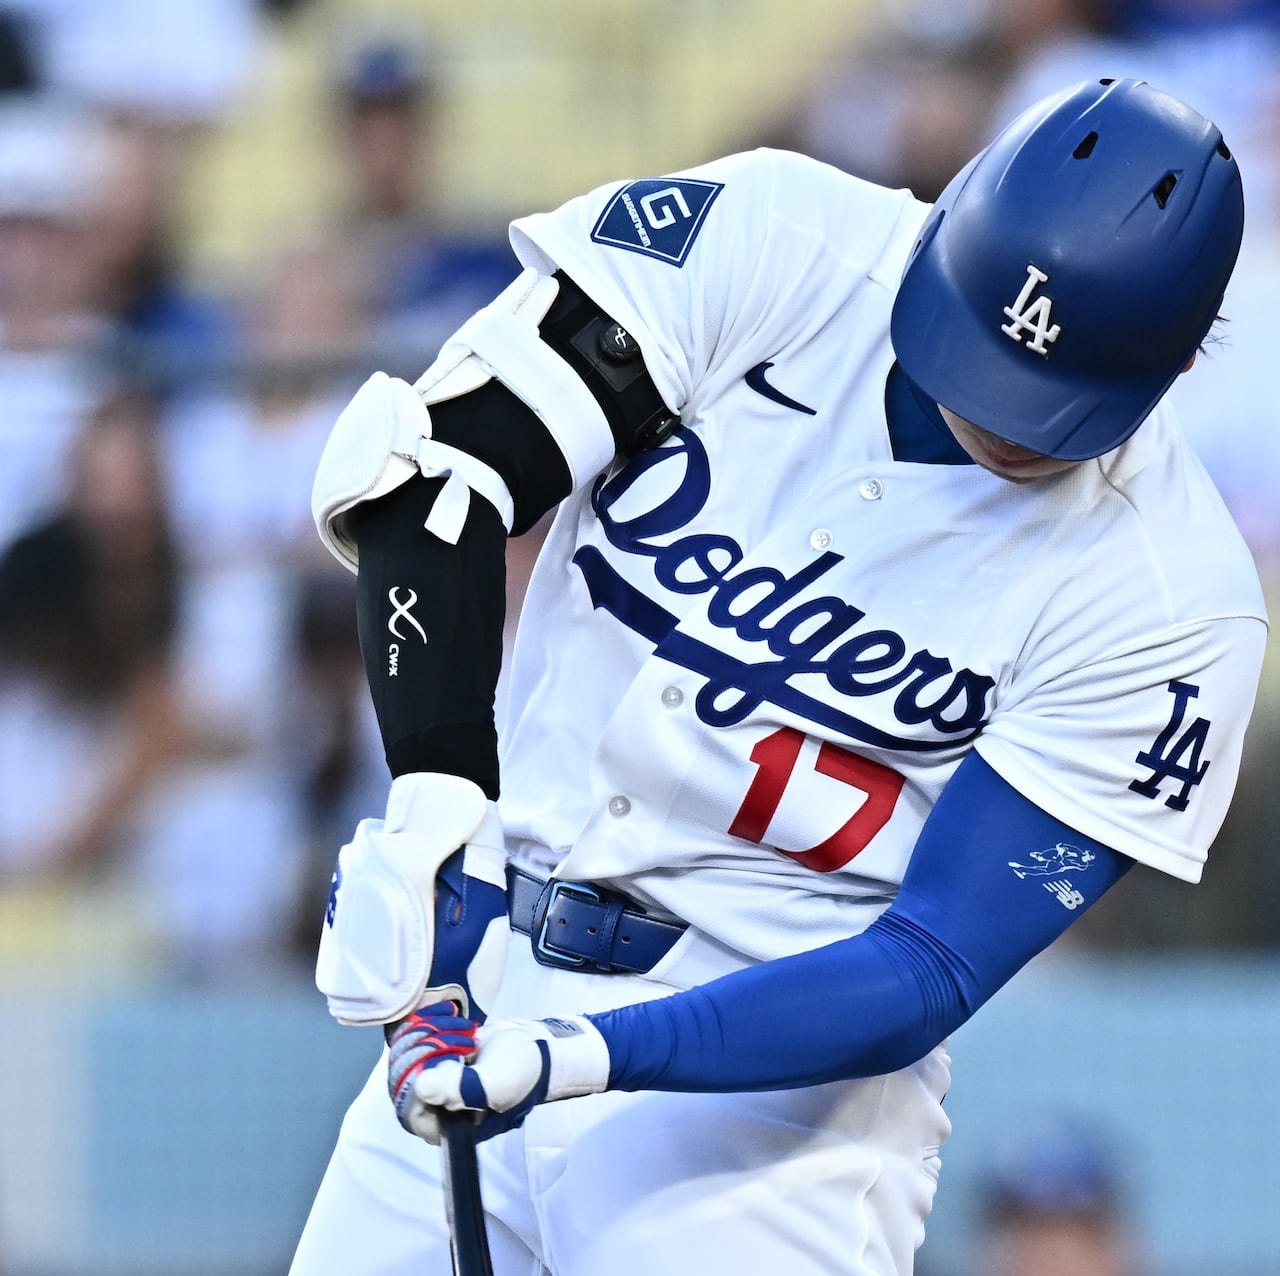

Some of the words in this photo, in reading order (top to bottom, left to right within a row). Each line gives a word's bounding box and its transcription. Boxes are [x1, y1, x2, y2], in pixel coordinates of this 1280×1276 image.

[640, 187, 692, 230] G
[1001, 264, 1061, 355] LA
[590, 425, 996, 735] Dodgers
[727, 726, 907, 873] 17
[1127, 679, 1212, 812] LA
